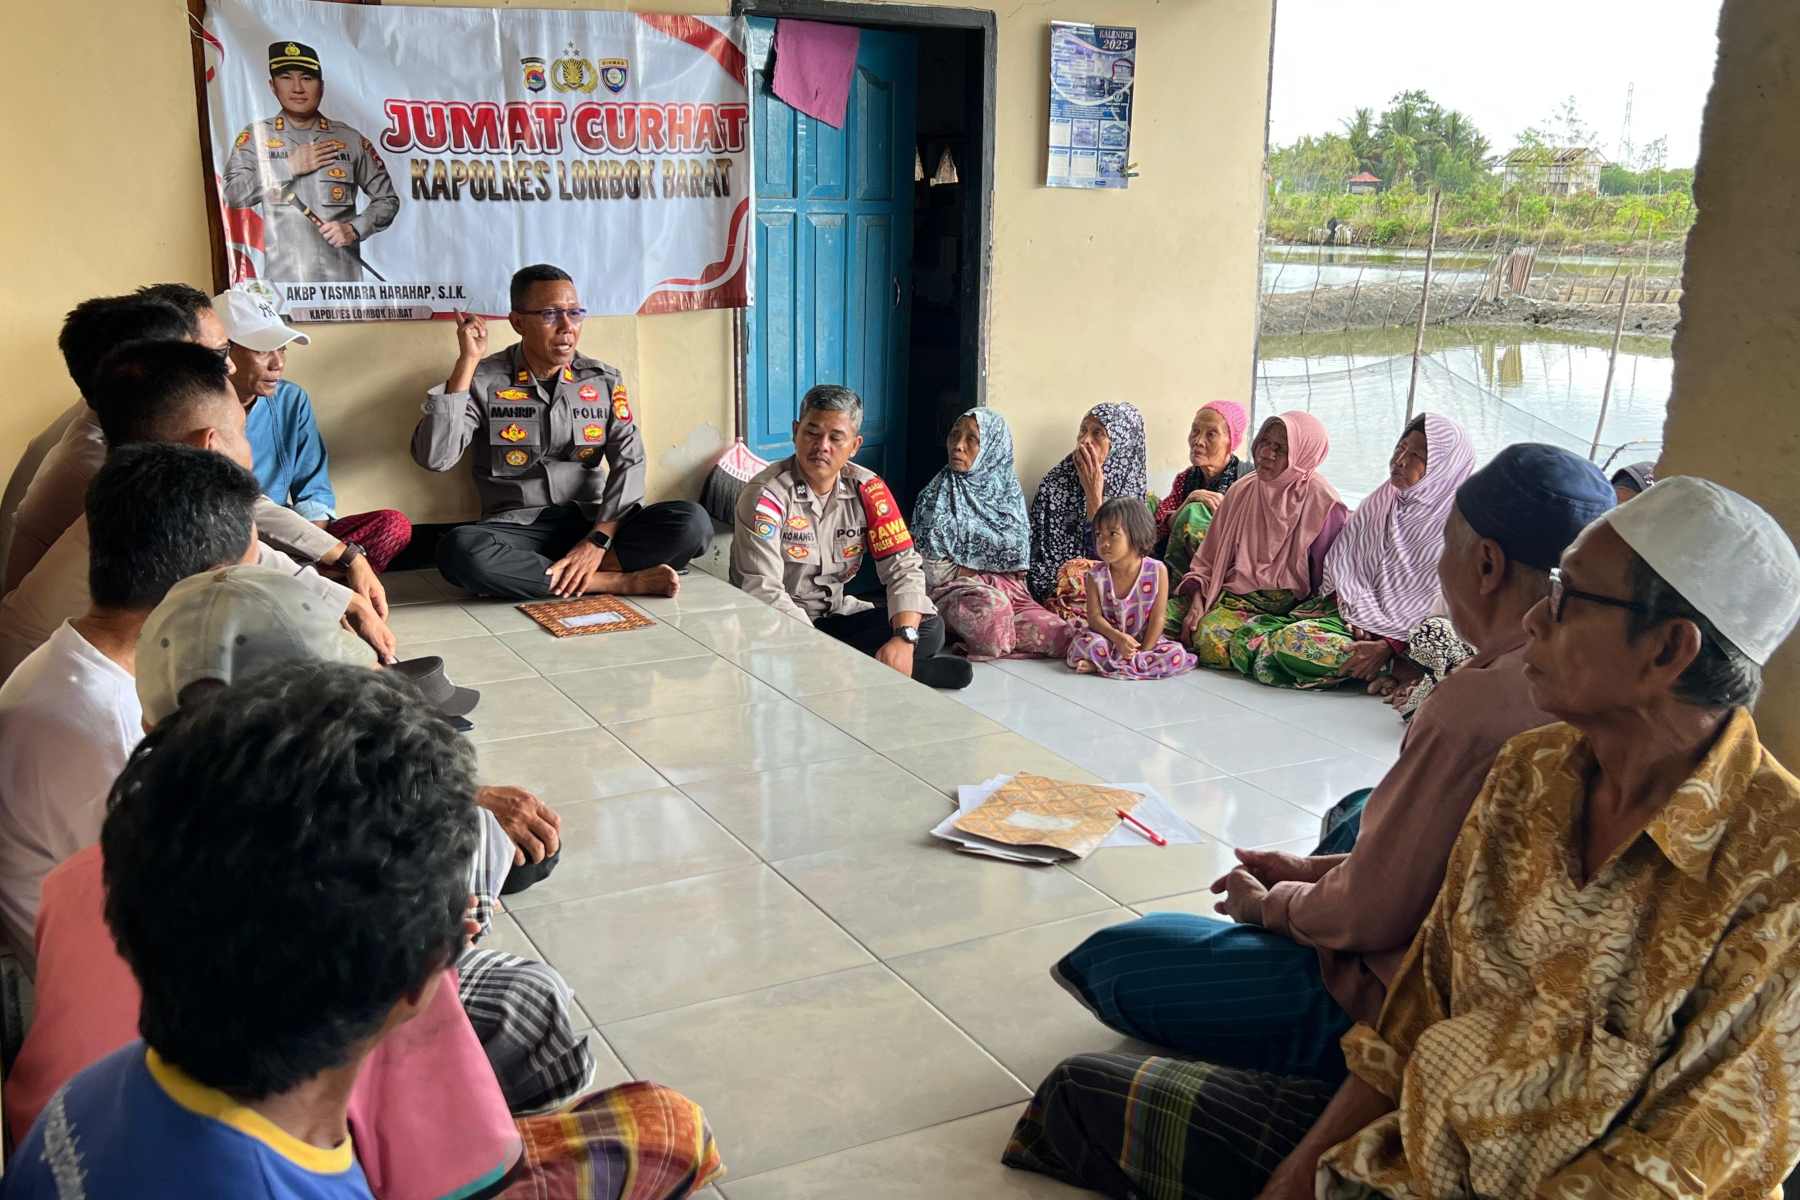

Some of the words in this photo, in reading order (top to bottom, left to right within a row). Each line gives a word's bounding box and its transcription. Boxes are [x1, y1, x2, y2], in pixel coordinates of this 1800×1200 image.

[1099, 31, 1134, 40] KALENDER
[1103, 39, 1129, 50] 2025
[382, 100, 566, 154] JUMAT
[572, 102, 747, 154] CURHAT
[410, 158, 552, 201] KAPOLRES
[557, 159, 657, 201] LOMBOK
[662, 158, 733, 199] BARAT
[287, 286, 316, 301] AKBP
[320, 286, 376, 300] YASMARA
[379, 285, 436, 300] HARAHAP,
[438, 285, 467, 299] S.I.K.
[491, 406, 537, 419] MAHRIP
[572, 406, 608, 419] POLRI
